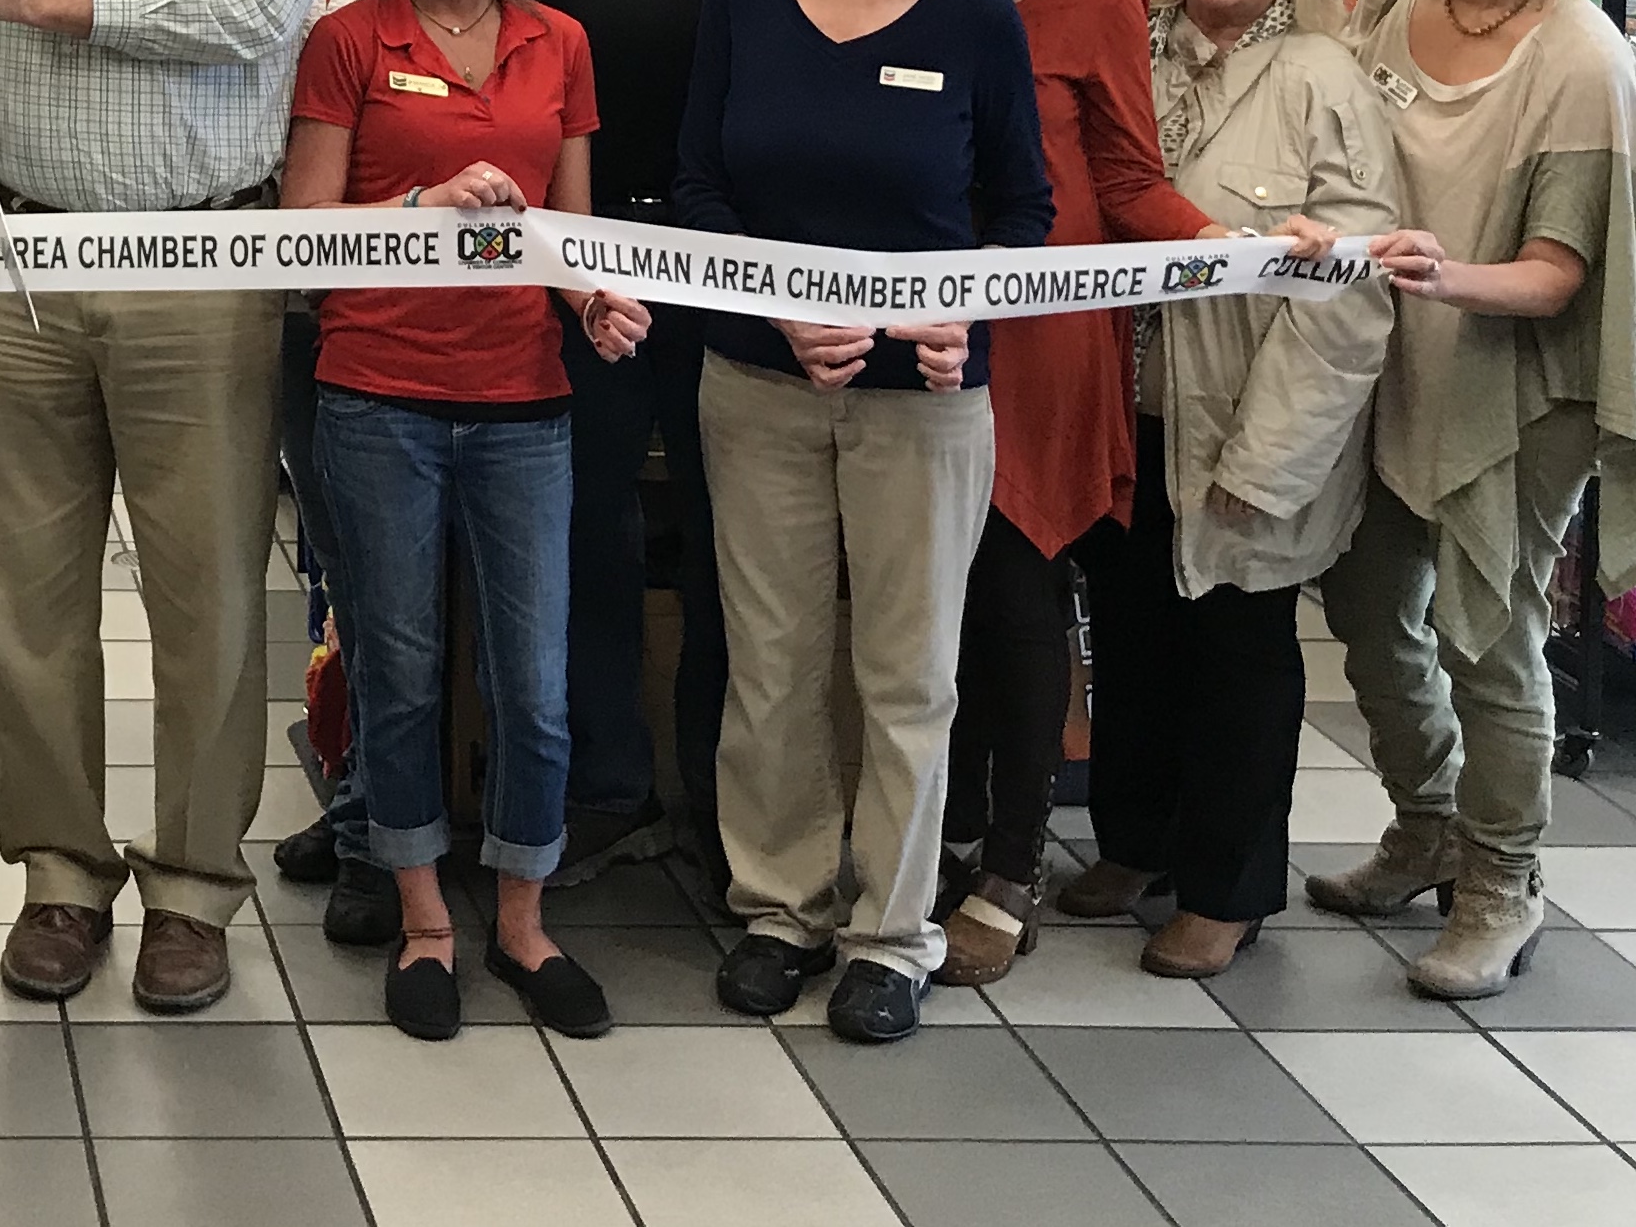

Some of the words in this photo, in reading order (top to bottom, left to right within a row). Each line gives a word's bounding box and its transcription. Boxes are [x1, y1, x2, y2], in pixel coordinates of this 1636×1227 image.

[77, 236, 218, 269] CHAMBER
[229, 234, 266, 268] OF
[276, 231, 440, 268] COMMERCE
[561, 237, 692, 285] CULLMAN
[702, 256, 776, 296] AREA
[786, 267, 928, 310] CHAMBER
[938, 274, 976, 308] OF
[984, 266, 1148, 306] COMMERCE
[1258, 254, 1382, 285] CULLMA
